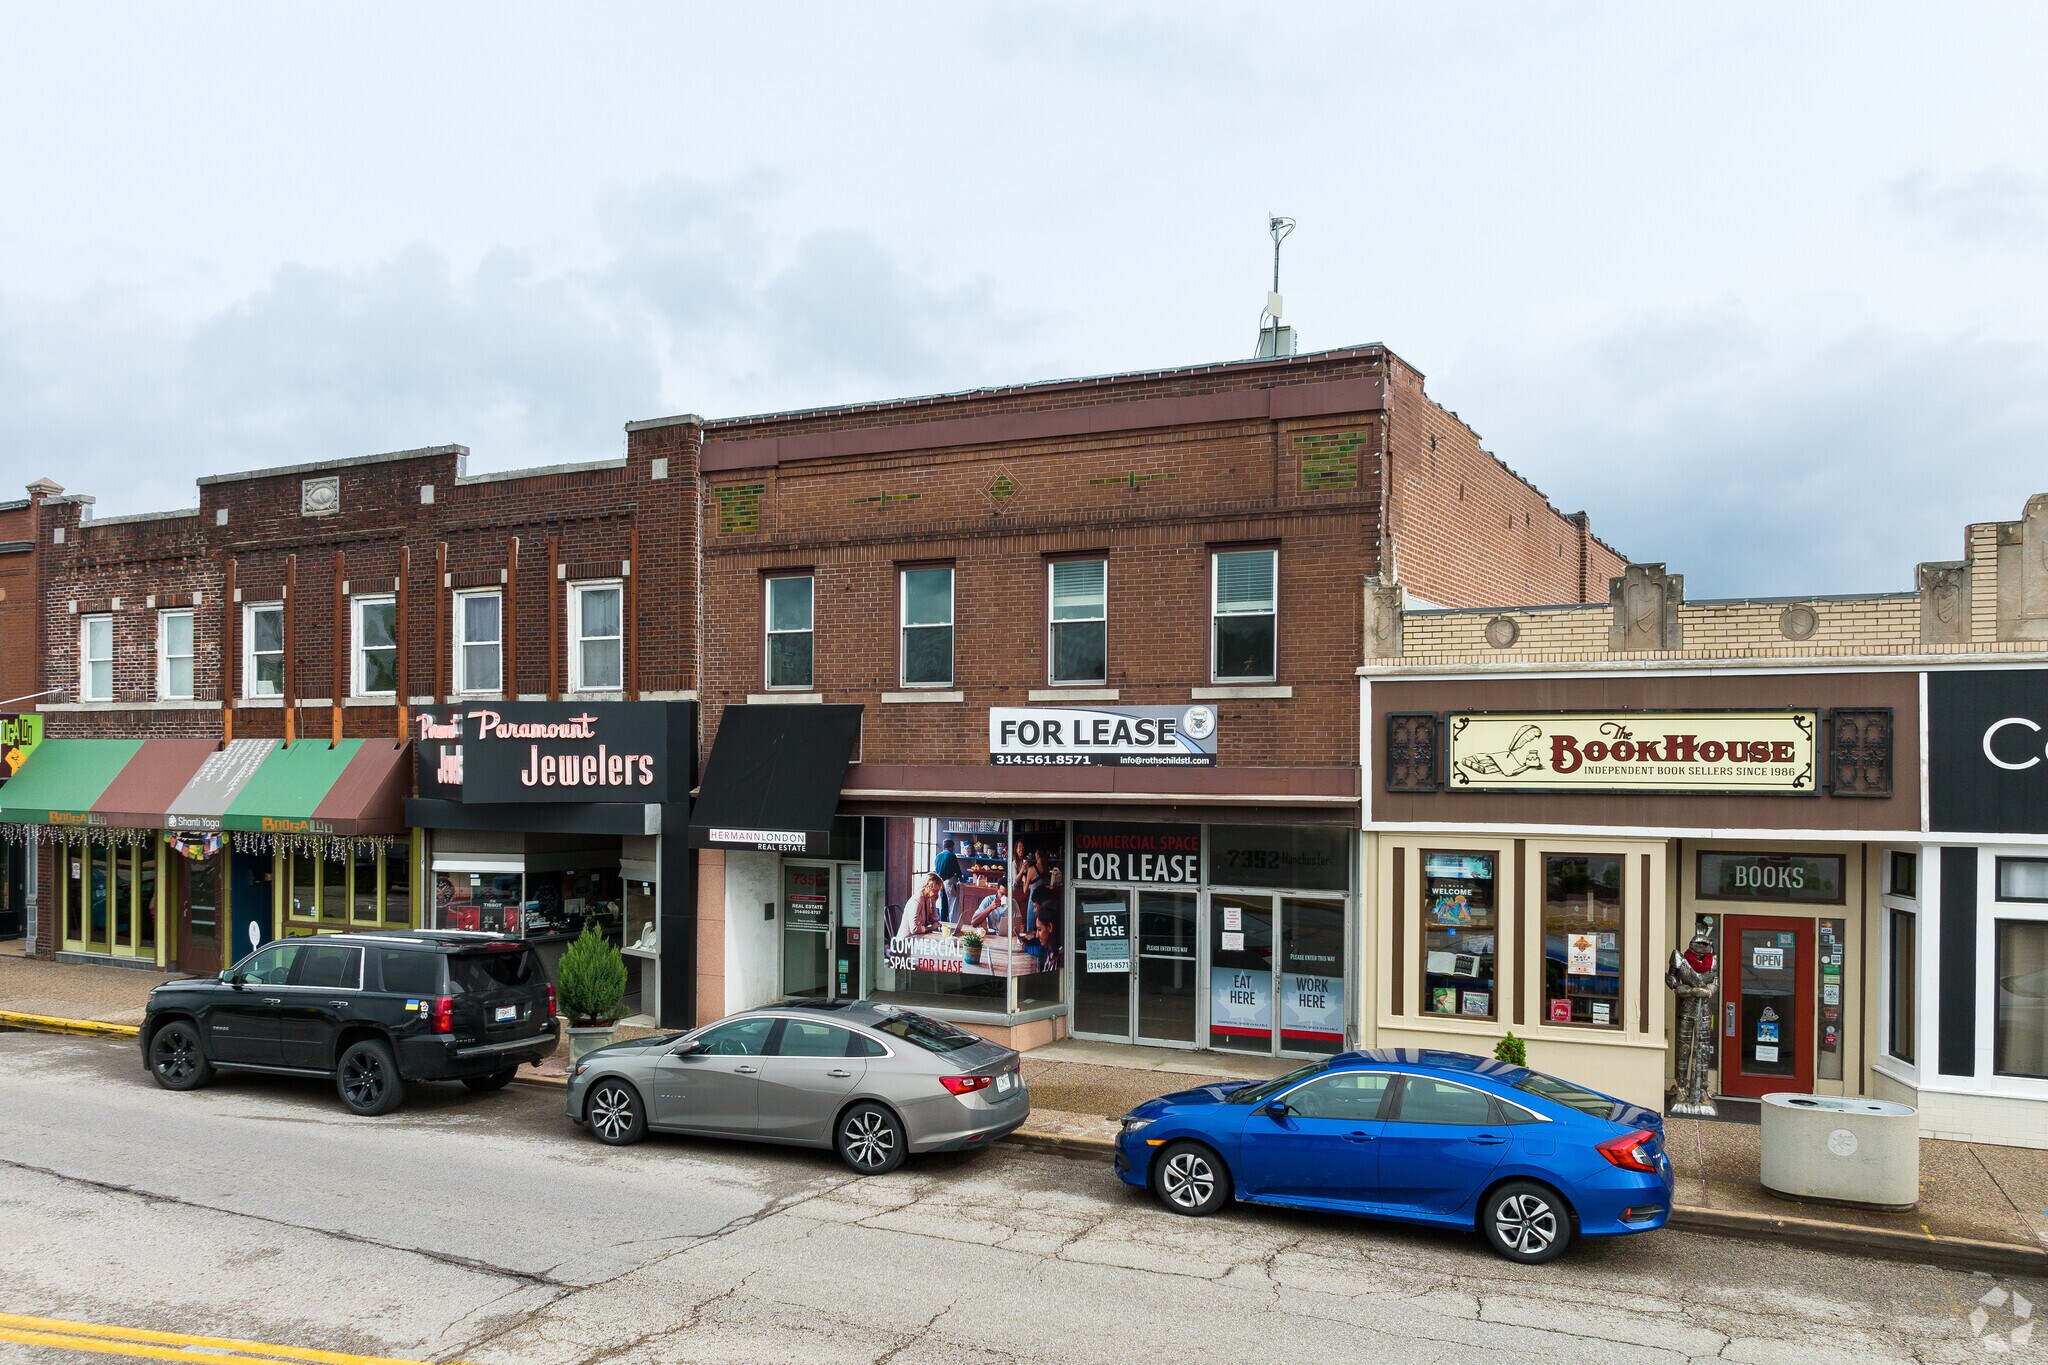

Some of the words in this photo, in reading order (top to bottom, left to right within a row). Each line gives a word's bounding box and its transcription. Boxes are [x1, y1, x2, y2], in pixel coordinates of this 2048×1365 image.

[467, 709, 598, 741] Paramount
[1000, 719, 1064, 746] FOR
[1073, 718, 1176, 746] LEASE
[1599, 722, 1633, 740] The
[1983, 717, 2048, 770] C
[521, 744, 653, 786] Jewelers
[996, 755, 1092, 765] 314.561.8571
[1120, 756, 1210, 765] info@rothschildstl.com
[1584, 765, 1655, 775] INDEPENDENT
[1657, 766, 1686, 775] BOOK
[1688, 766, 1733, 776] SELLERS
[1736, 767, 1768, 776] SINCE
[1770, 767, 1796, 776] 1986
[178, 816, 201, 827] Shanti
[201, 818, 220, 829] Yoga
[262, 817, 333, 834] BOOGALOO
[1076, 834, 1156, 850] COMMERCIAL
[1160, 836, 1198, 851] SPACE
[1227, 849, 1280, 869] 7352
[1282, 852, 1329, 866] Manchester
[1077, 852, 1121, 880] FOR
[1128, 853, 1198, 883] LEASE
[1735, 865, 1804, 889] BOOKS
[1432, 888, 1473, 896] WELCOME
[1093, 914, 1117, 926] FOR
[1089, 926, 1125, 937] LEASE
[890, 936, 963, 957] COMMERCIAL
[1146, 944, 1159, 952] PLEASE
[890, 956, 916, 971] SPACE
[917, 958, 935, 972] FOR
[937, 959, 963, 975] LEASE
[1087, 962, 1129, 970] (314)561-8571
[1755, 955, 1781, 967] OPEN
[1234, 975, 1252, 989] EAT
[1296, 977, 1328, 993] WORK
[1230, 991, 1255, 1005] HERE
[1299, 994, 1326, 1008] HERE
